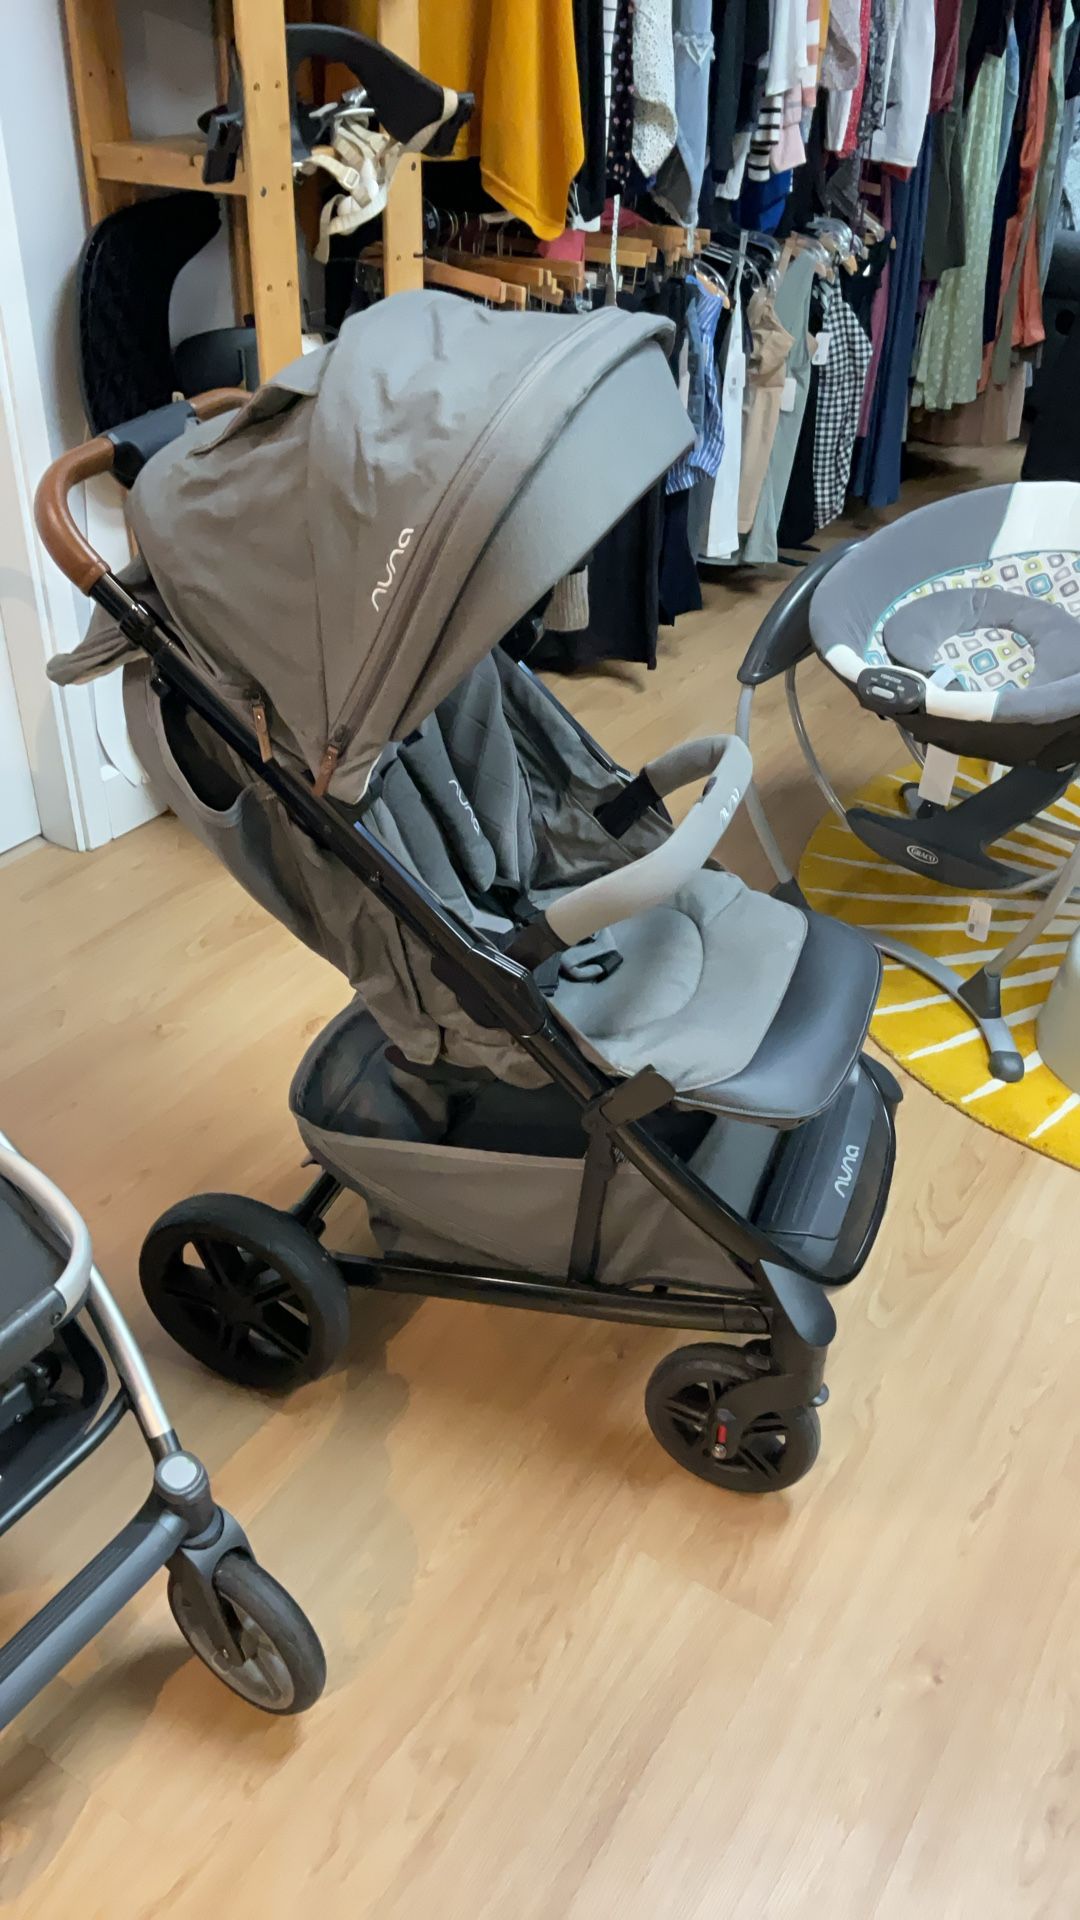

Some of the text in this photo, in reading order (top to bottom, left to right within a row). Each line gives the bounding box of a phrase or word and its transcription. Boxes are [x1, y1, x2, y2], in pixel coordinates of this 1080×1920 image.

[371, 527, 415, 612] nuna
[448, 780, 480, 836] nuna
[834, 1144, 860, 1199] nuna
